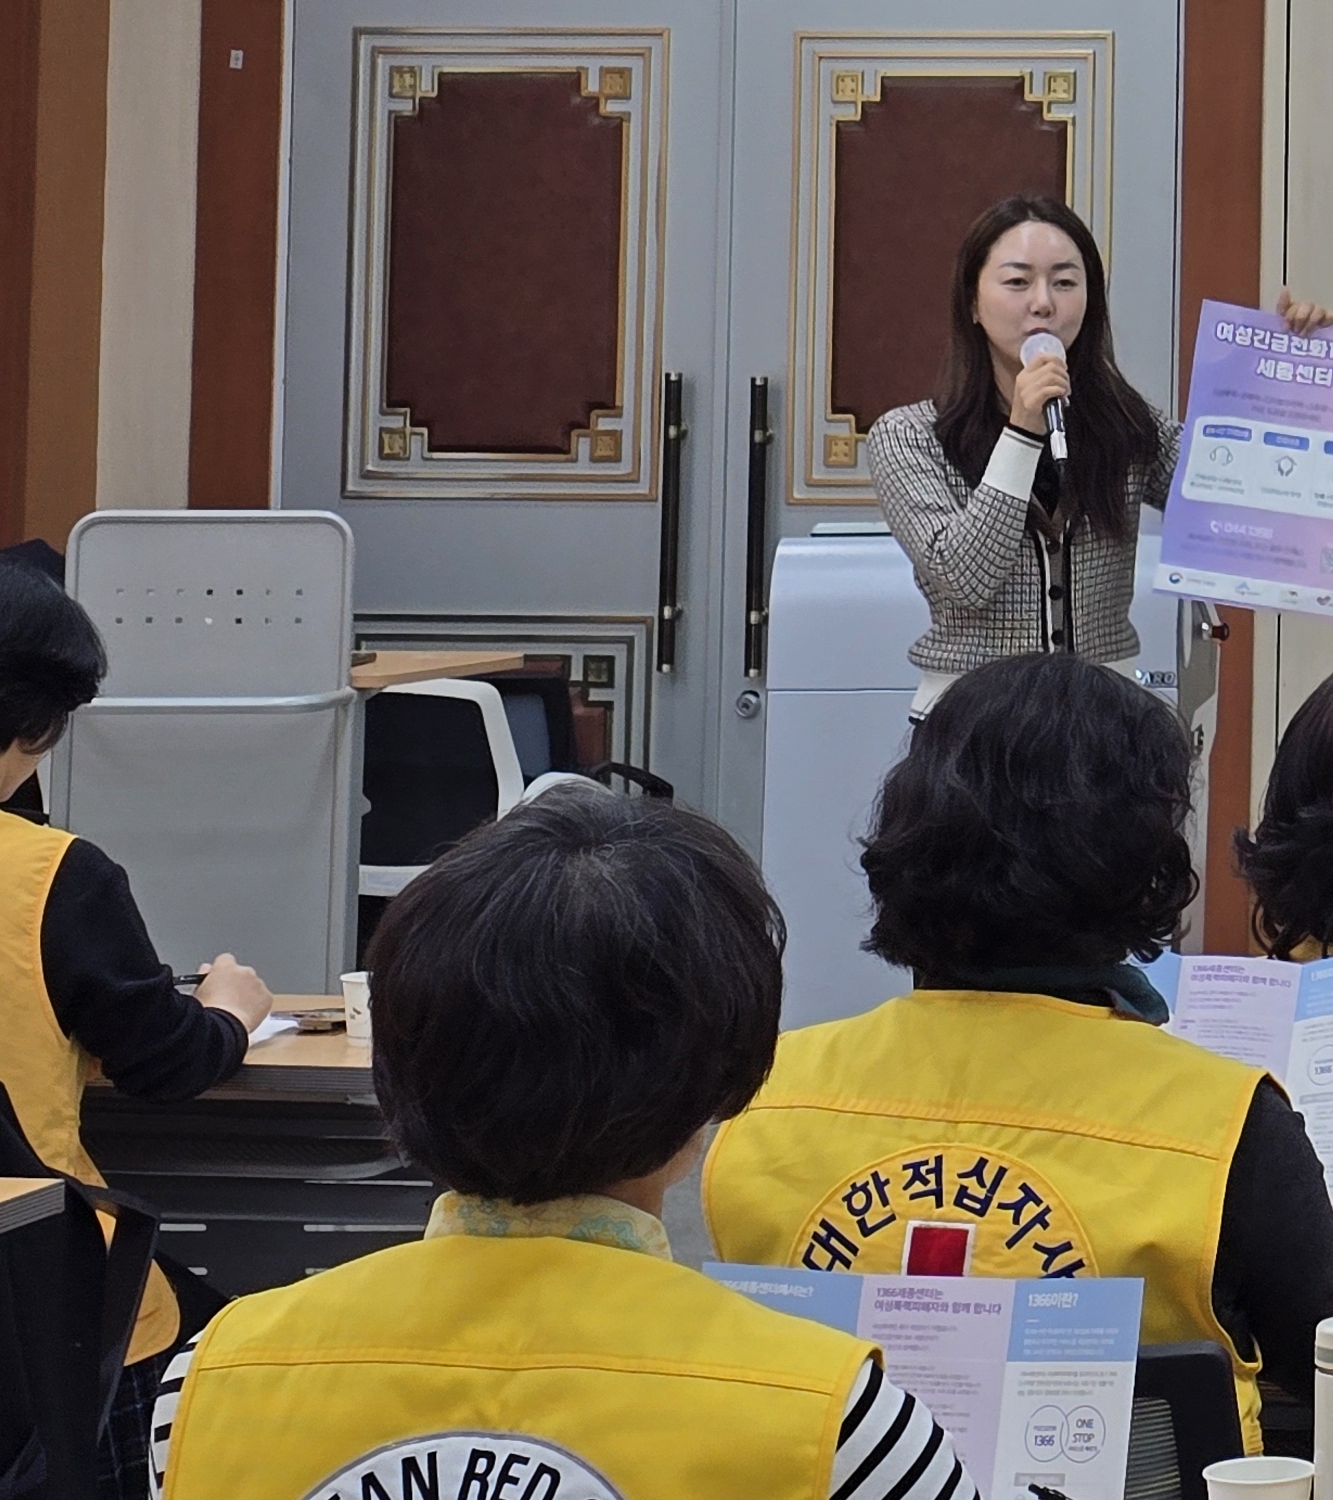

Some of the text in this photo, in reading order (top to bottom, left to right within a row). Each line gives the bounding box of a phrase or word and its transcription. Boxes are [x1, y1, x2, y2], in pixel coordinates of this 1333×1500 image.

[1256, 357, 1333, 388] 세종센터
[1075, 1418, 1094, 1429] ONE
[1033, 1435, 1055, 1446] 1366
[1072, 1432, 1095, 1444] STOP
